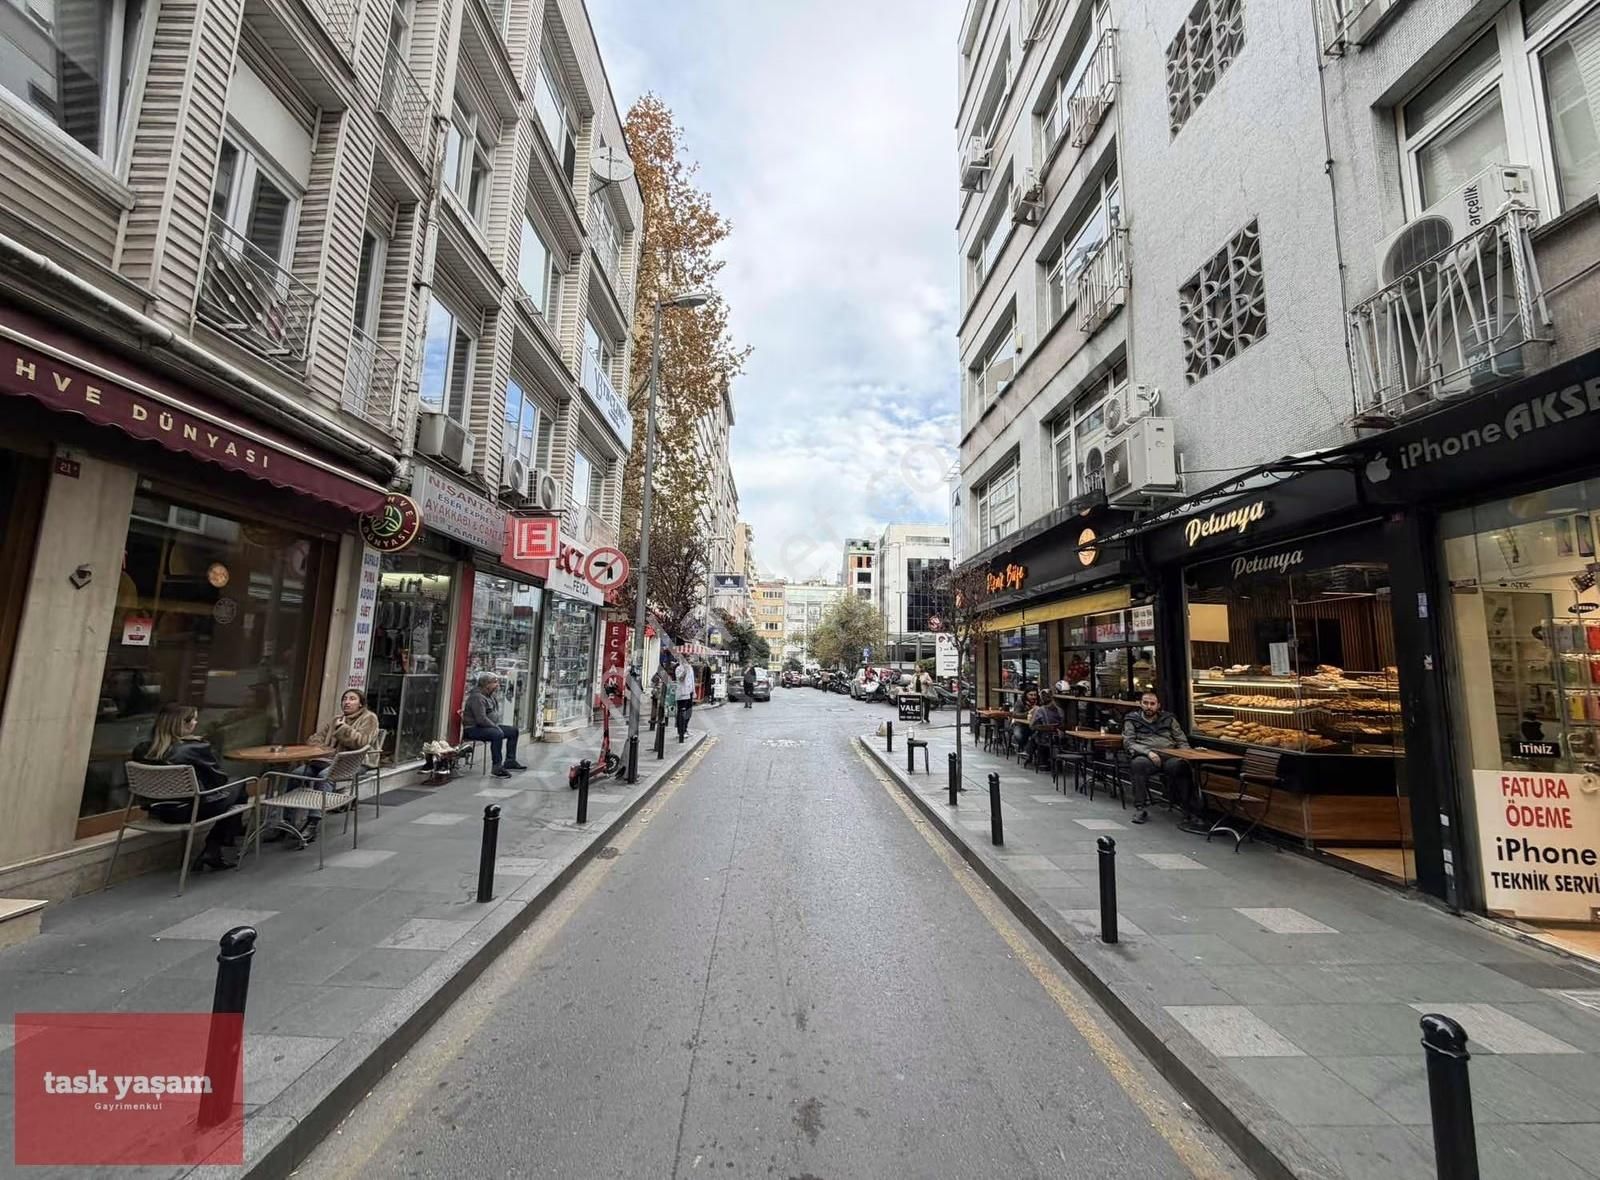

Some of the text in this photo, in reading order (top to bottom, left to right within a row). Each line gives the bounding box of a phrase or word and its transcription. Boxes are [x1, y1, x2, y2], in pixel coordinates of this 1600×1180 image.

[1463, 184, 1482, 227] arçelik
[132, 404, 269, 468] DÜNYASI
[1400, 423, 1501, 470] iPhone
[1185, 500, 1265, 547] Petunya
[556, 541, 586, 579] ECZ
[1232, 550, 1304, 580] Petunya
[900, 704, 920, 712] VALE
[1501, 776, 1570, 799] FATURA
[1505, 800, 1573, 829] ÖDEME
[1496, 836, 1597, 866] iPhone
[1491, 870, 1550, 891] TEKNİK
